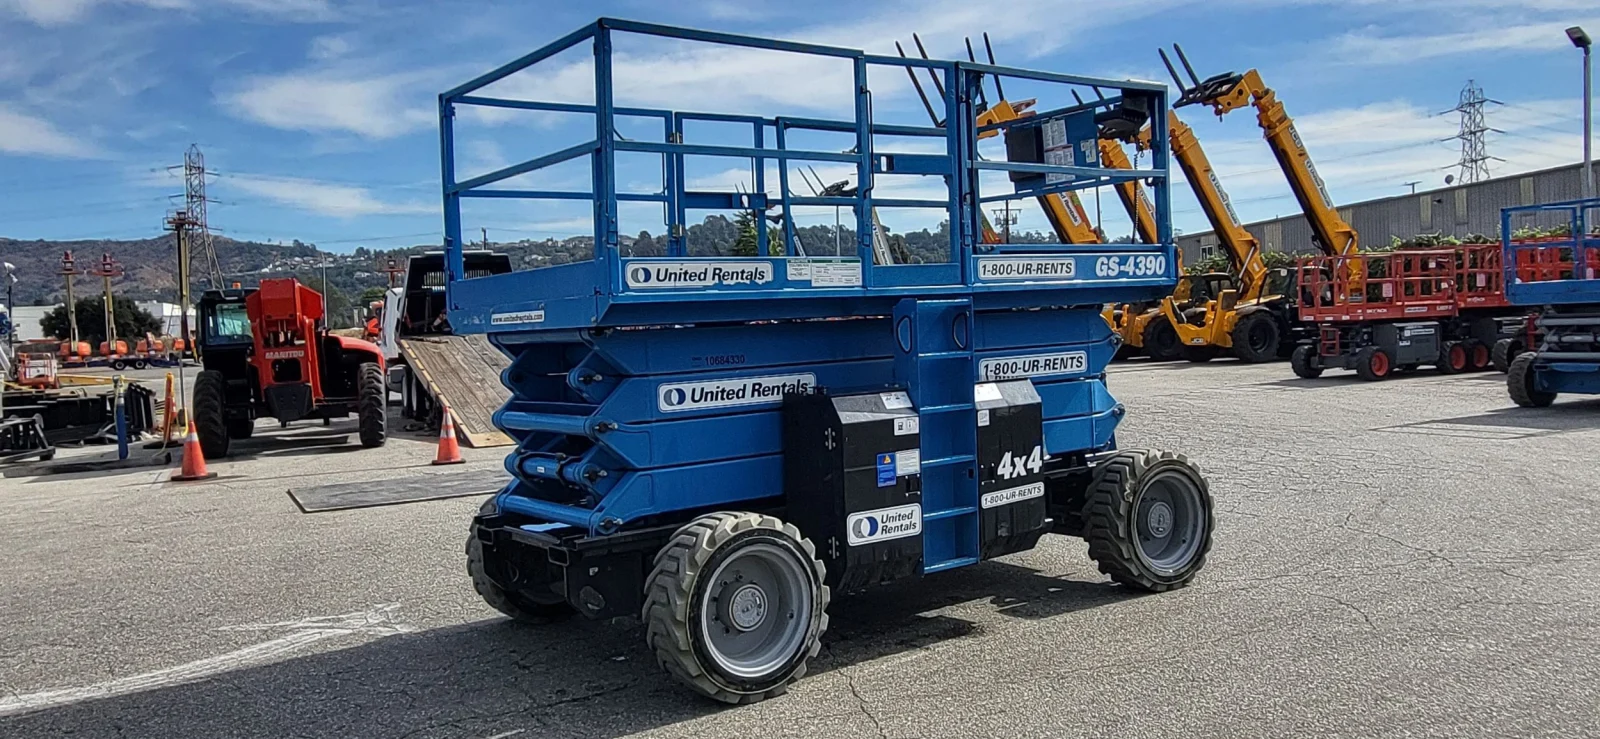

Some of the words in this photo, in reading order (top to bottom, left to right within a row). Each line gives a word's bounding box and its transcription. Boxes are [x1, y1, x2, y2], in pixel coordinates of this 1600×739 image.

[656, 267, 708, 282] United
[712, 266, 765, 281] Rentals
[981, 262, 1073, 276] 1-800-UR-RENTS
[1095, 255, 1166, 277] GS-4390
[265, 350, 305, 359] MANITOU
[705, 354, 746, 366] 10684330
[983, 356, 1084, 376] 1-800-UR-RENTS
[690, 383, 747, 404] United
[750, 379, 808, 399] Rentals
[997, 445, 1042, 480] 4x4
[984, 486, 1042, 505] 1-800-UR-RENTS
[881, 509, 914, 524] United
[881, 520, 917, 535] Rentals
